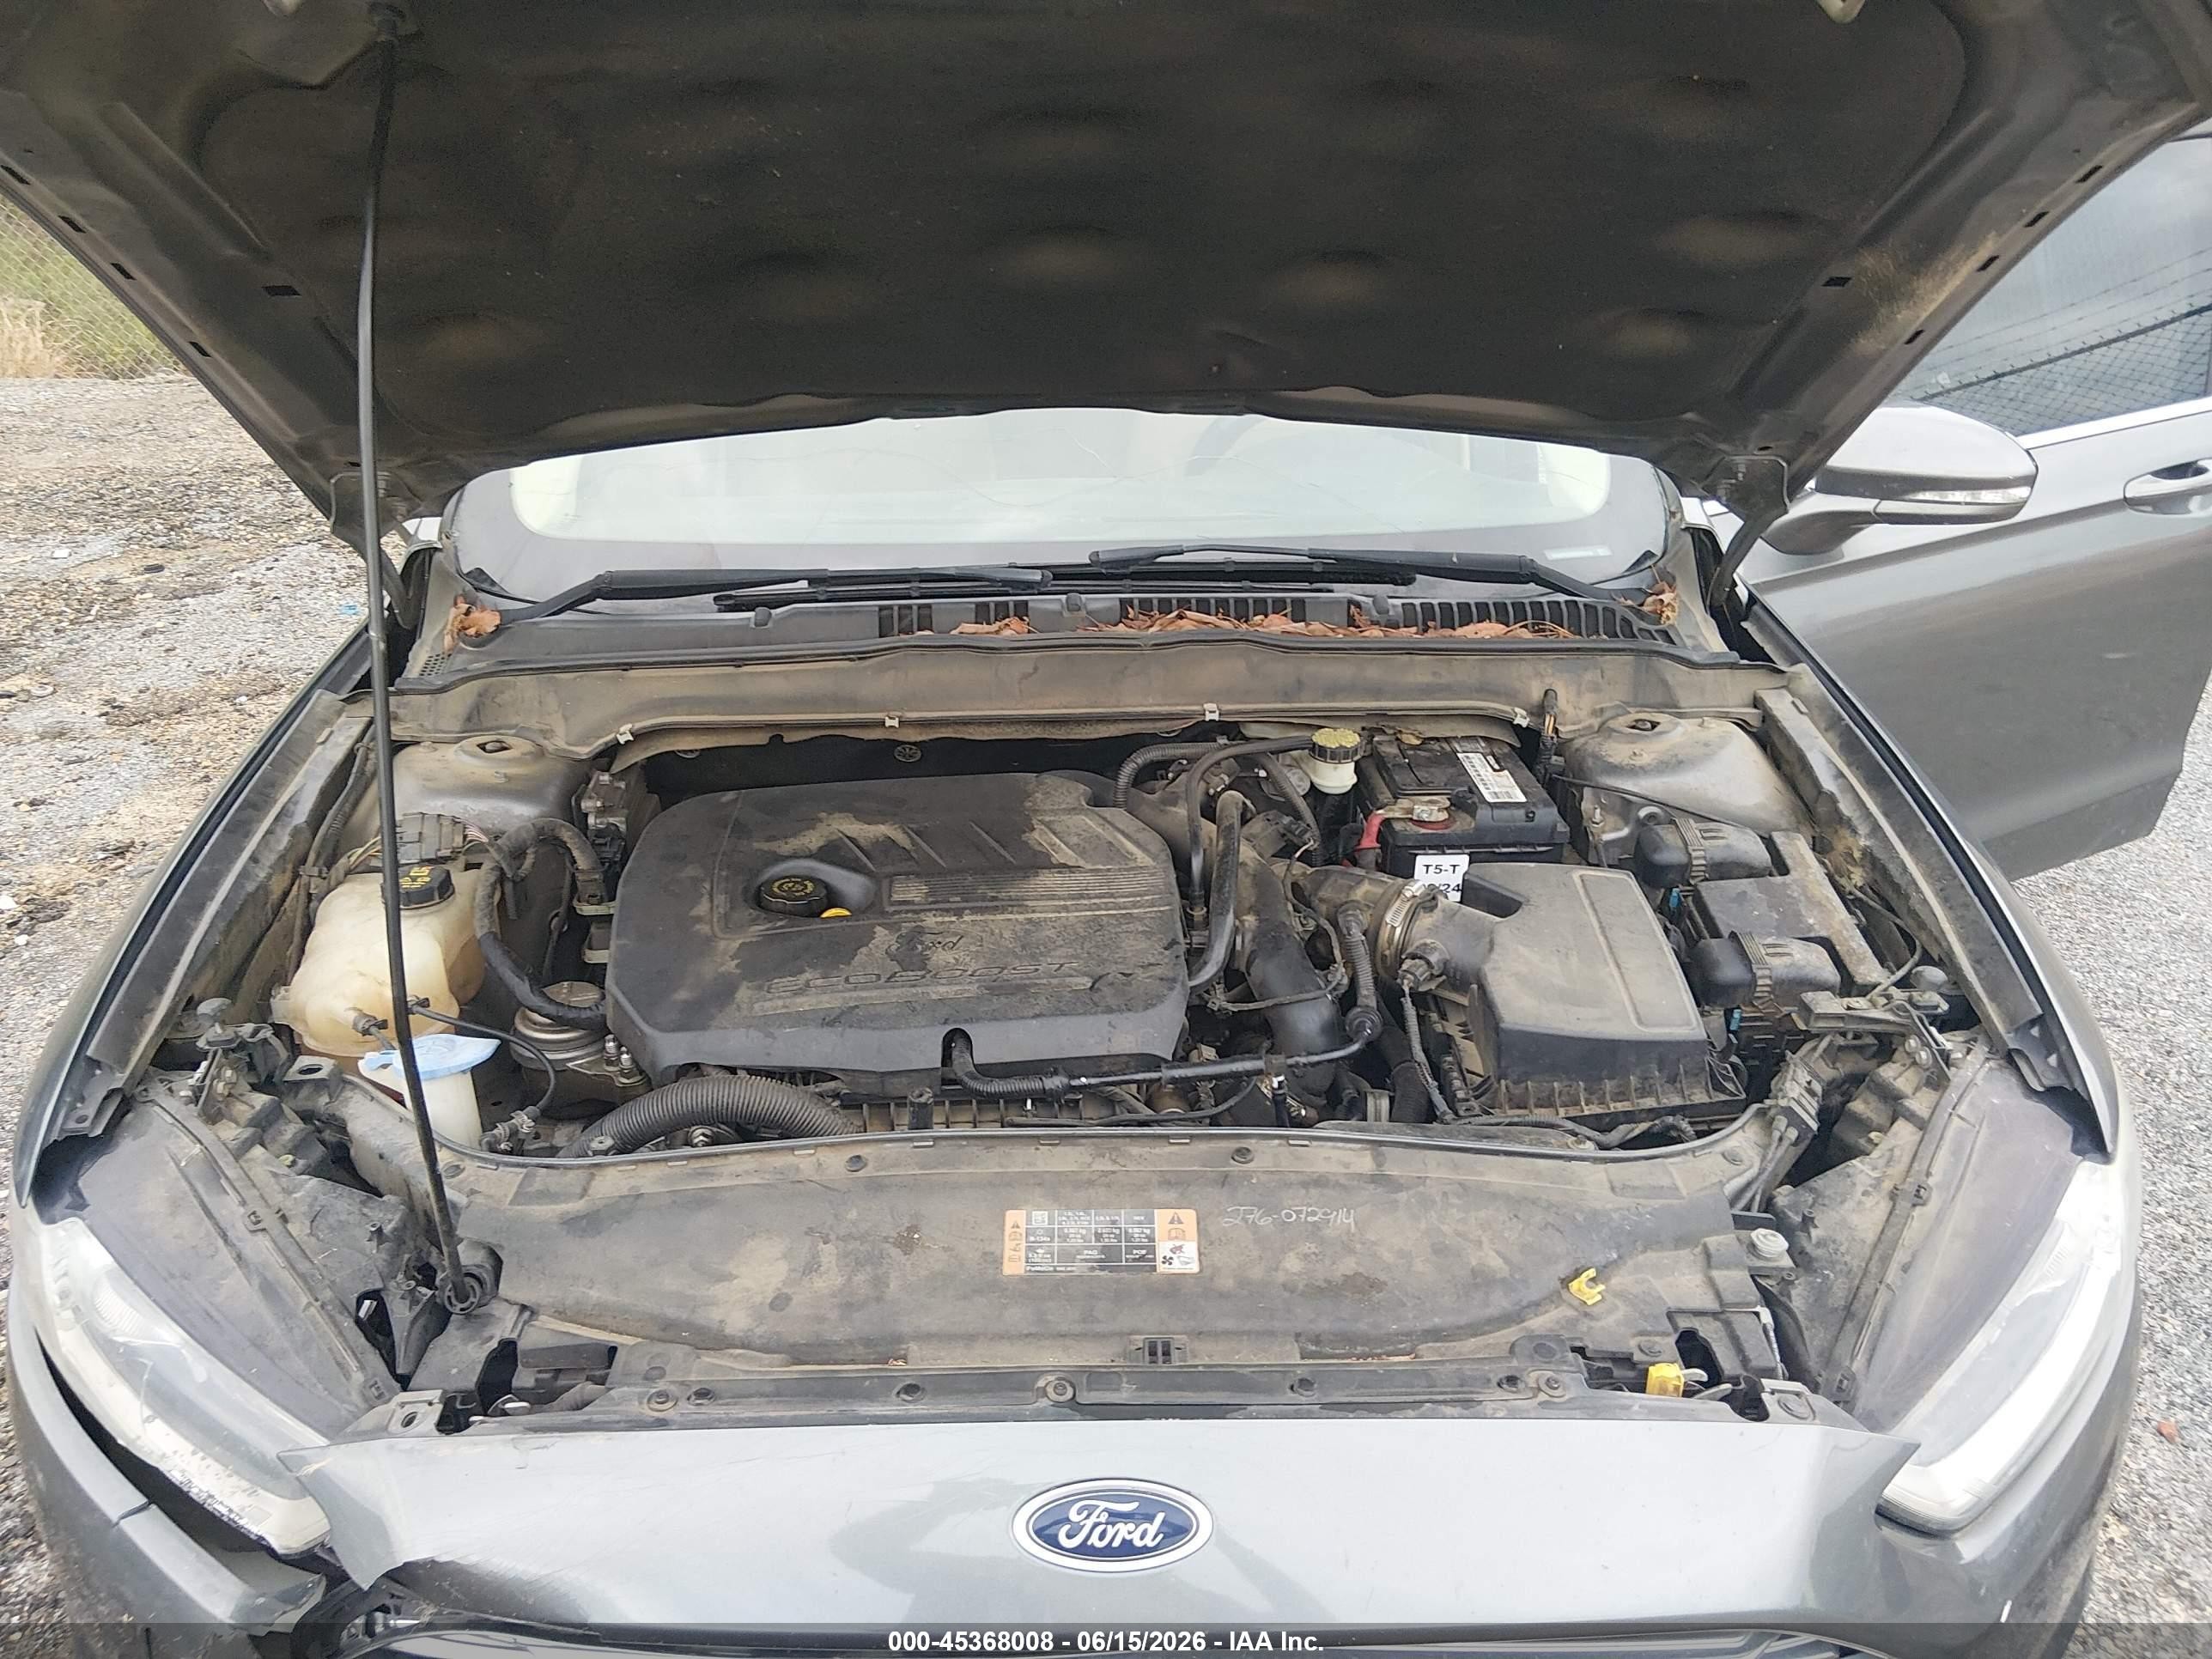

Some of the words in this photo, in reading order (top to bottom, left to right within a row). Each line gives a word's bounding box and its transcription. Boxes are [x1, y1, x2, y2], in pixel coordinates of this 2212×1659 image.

[1421, 864, 1461, 874] T5-T
[764, 962, 1079, 994] ECOBOOST
[1058, 1499, 1166, 1548] Ford
